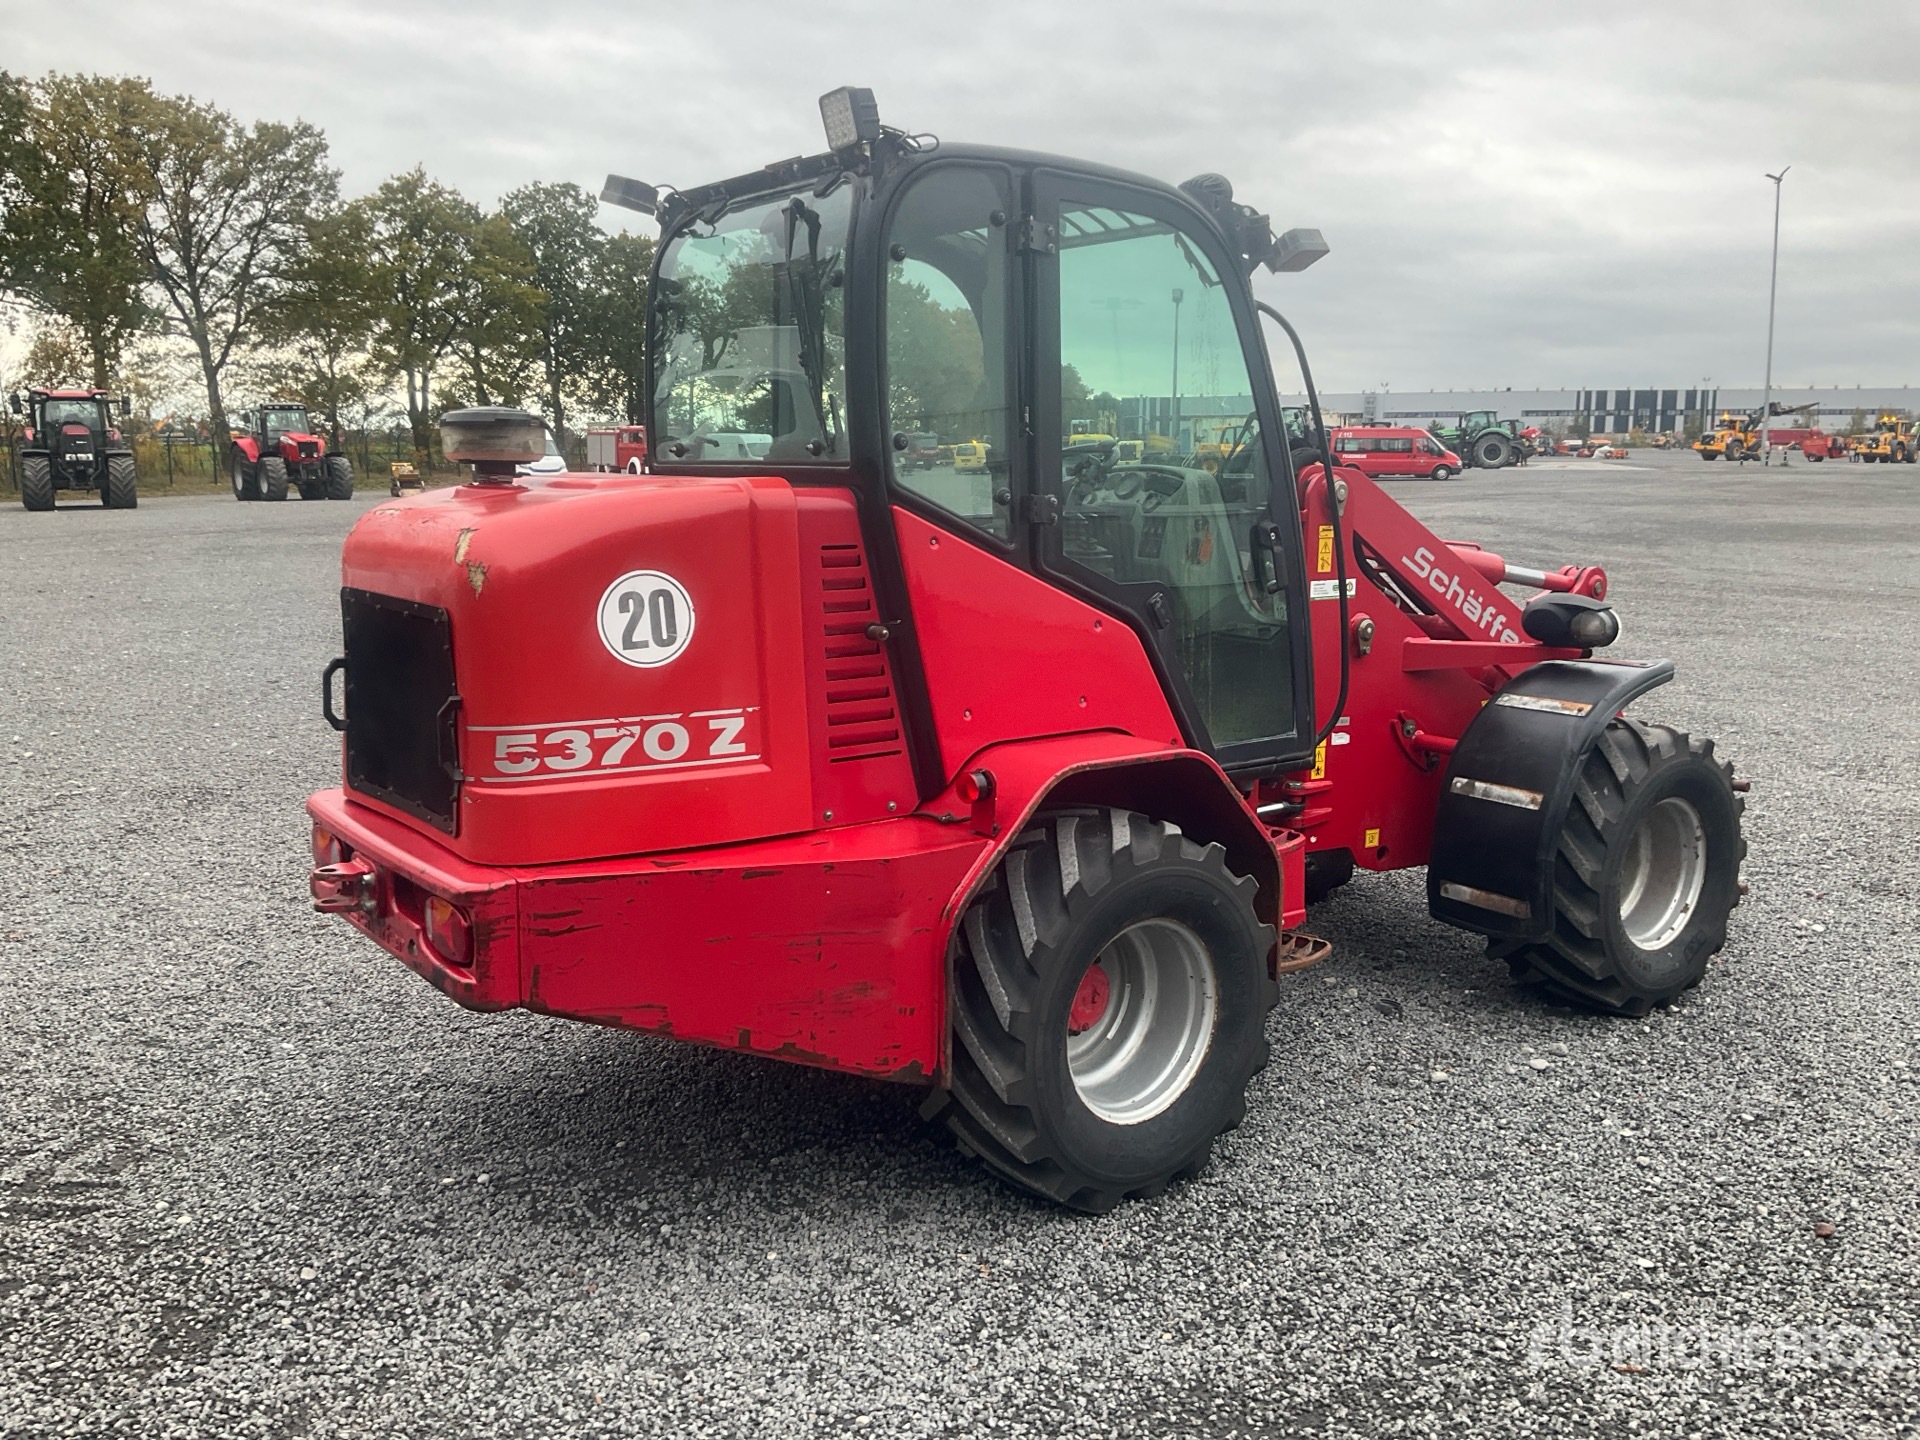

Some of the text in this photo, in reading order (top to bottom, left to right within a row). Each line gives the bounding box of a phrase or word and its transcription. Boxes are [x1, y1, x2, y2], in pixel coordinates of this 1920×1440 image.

[618, 588, 678, 650] 20
[1401, 547, 1525, 644] Schäffe
[493, 716, 746, 774] 5370 Z
